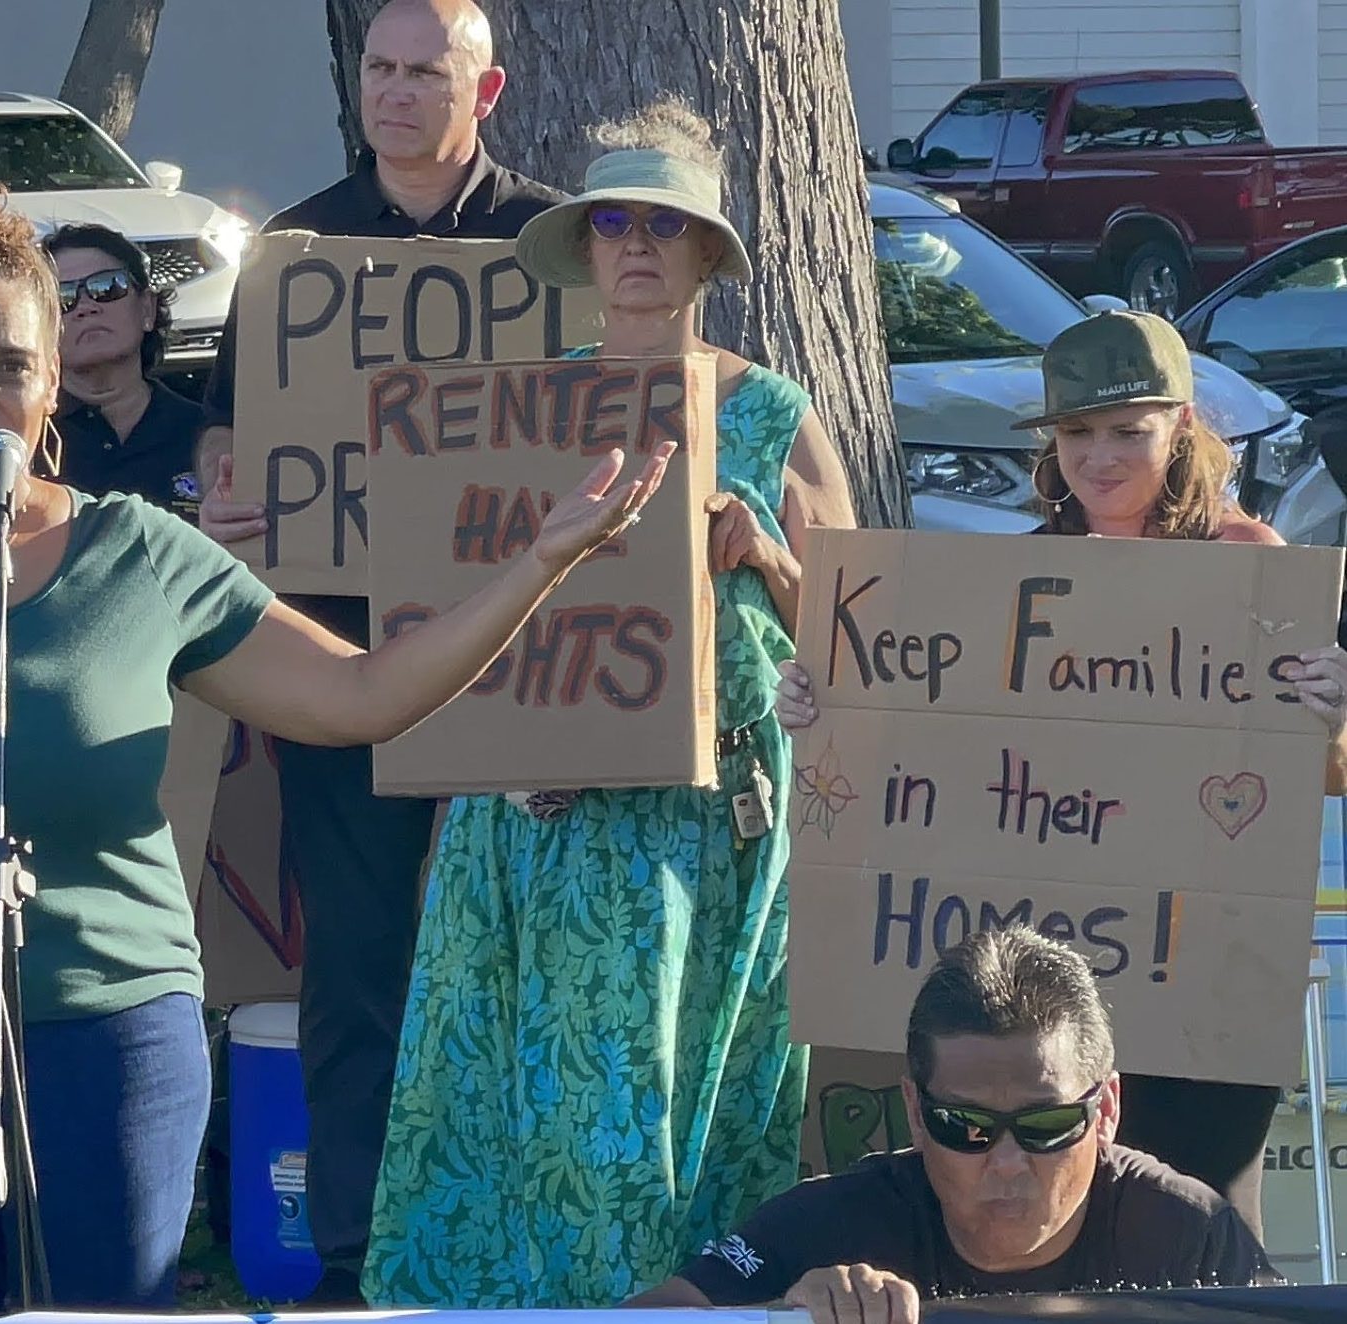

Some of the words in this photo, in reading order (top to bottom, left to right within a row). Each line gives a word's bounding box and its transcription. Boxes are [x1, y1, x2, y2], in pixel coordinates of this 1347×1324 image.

[1097, 383, 1126, 397] MAUI
[1128, 380, 1150, 393] LIFE
[828, 564, 963, 704] Keep
[1005, 576, 1303, 704] Families
[884, 763, 936, 828] in
[985, 748, 1126, 845] their
